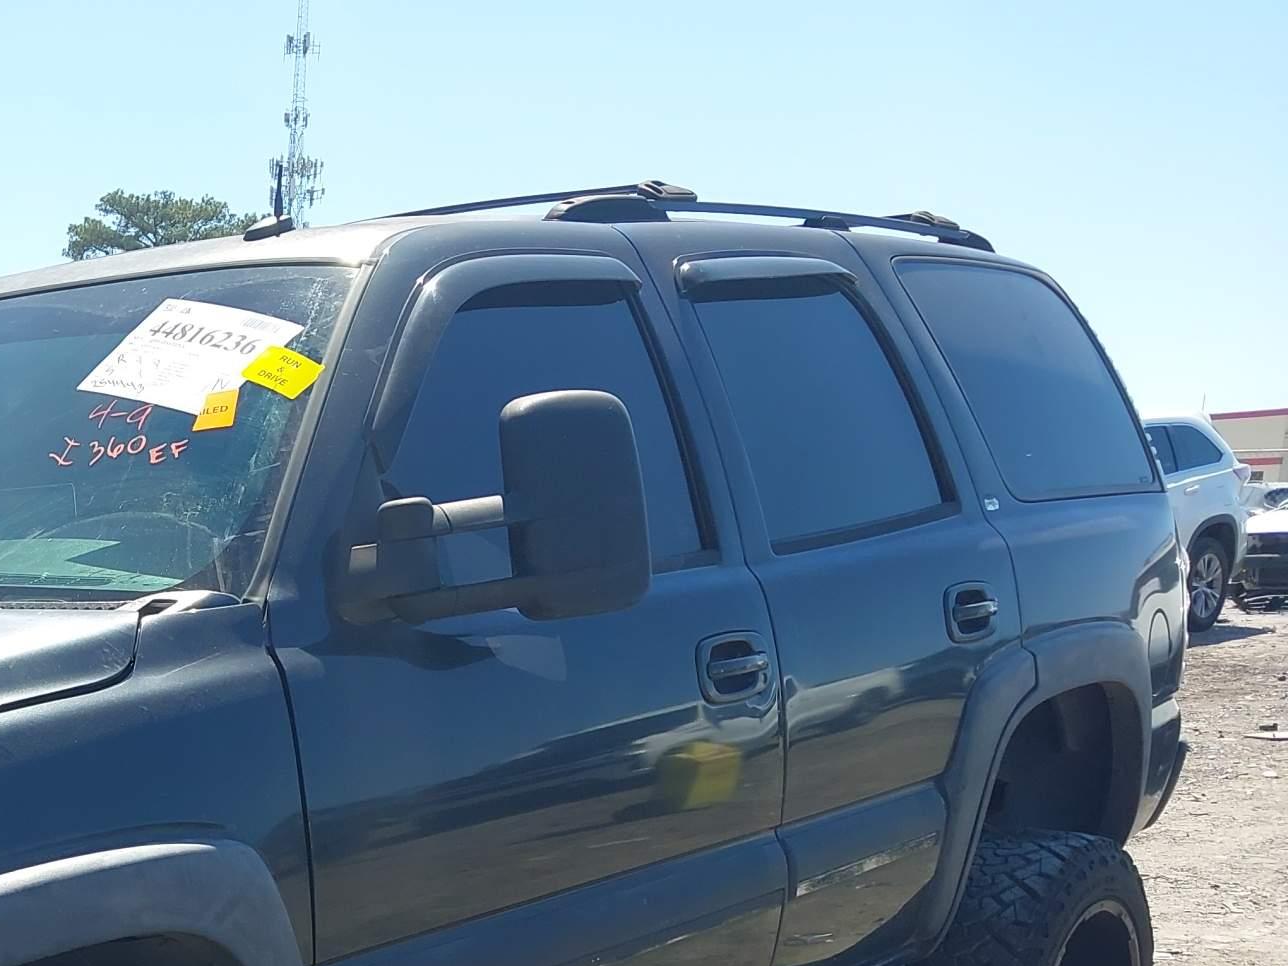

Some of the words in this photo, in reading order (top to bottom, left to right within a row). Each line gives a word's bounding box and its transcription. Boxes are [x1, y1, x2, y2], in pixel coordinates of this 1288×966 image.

[149, 320, 261, 356] 44816236
[279, 354, 303, 369] RUN
[257, 369, 289, 387] DRIVE
[88, 399, 154, 430] 4-9
